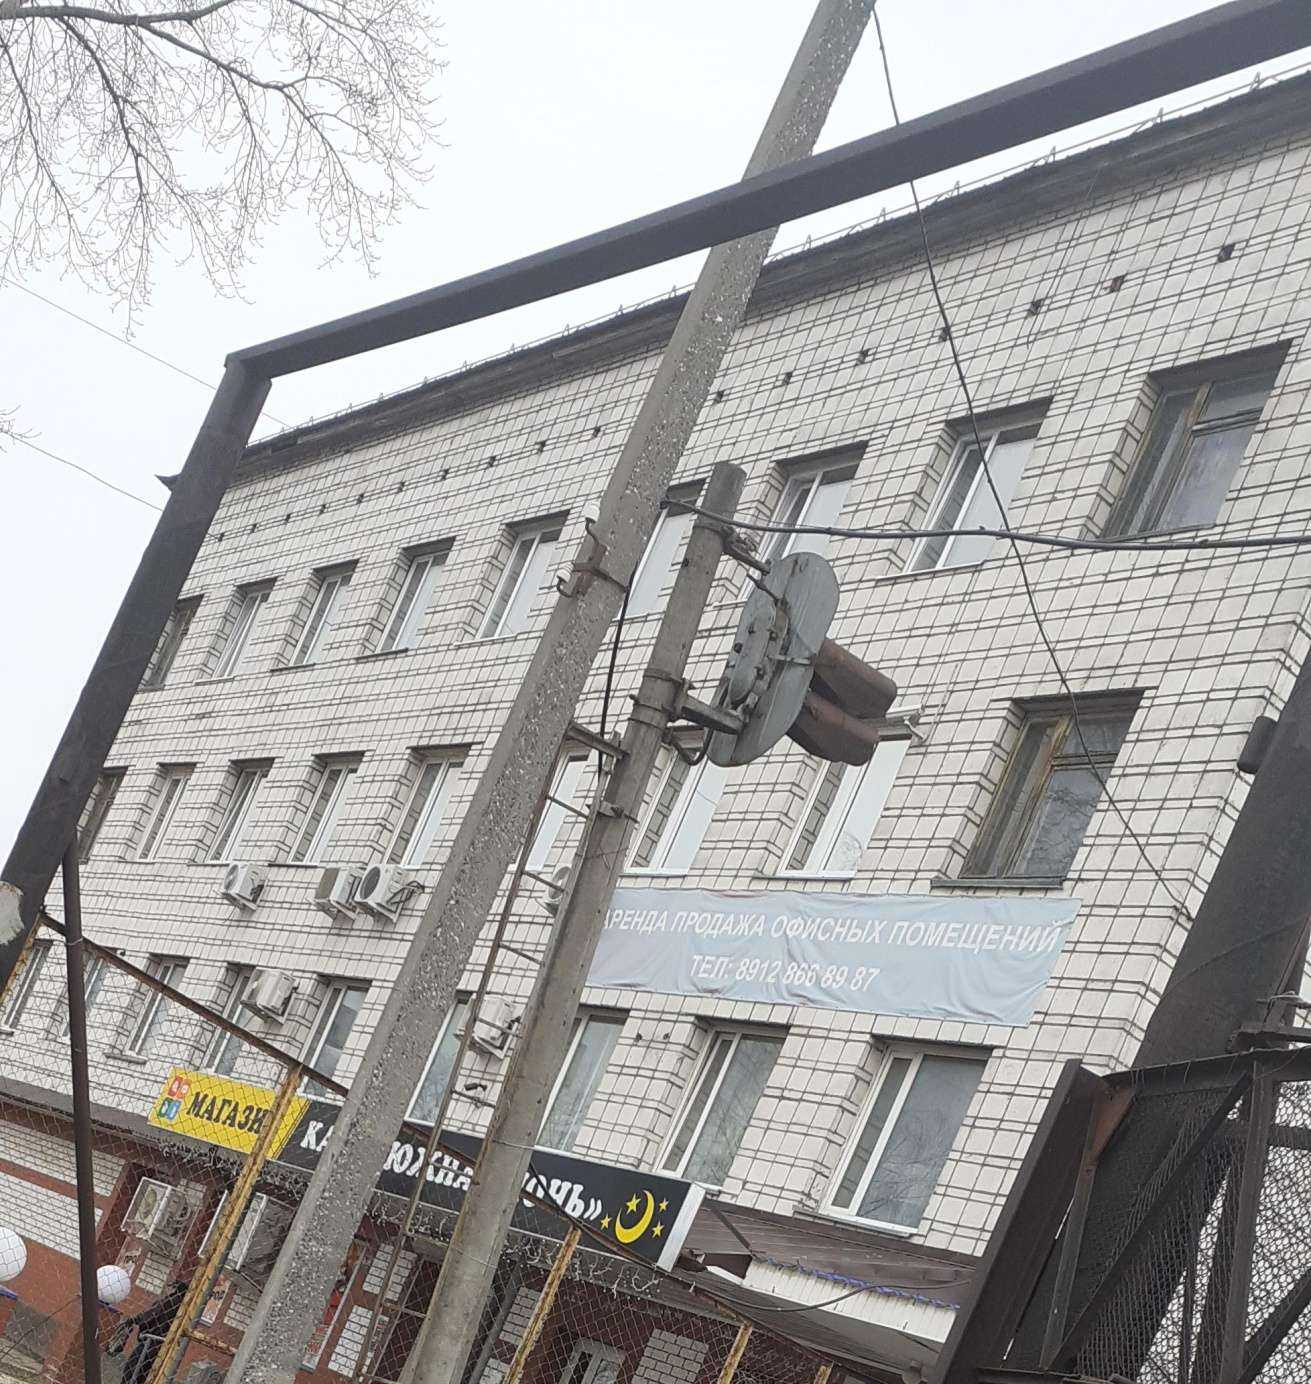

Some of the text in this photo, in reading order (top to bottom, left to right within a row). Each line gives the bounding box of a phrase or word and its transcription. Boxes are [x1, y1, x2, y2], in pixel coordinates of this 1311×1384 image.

[671, 911, 764, 938] ПРОДАЖА
[771, 914, 887, 944] ОФИСНЫХ
[887, 919, 1063, 954] ПОМЕЩЕНИЙ
[689, 954, 880, 992] ТЕЛ: 8912 866 89 87
